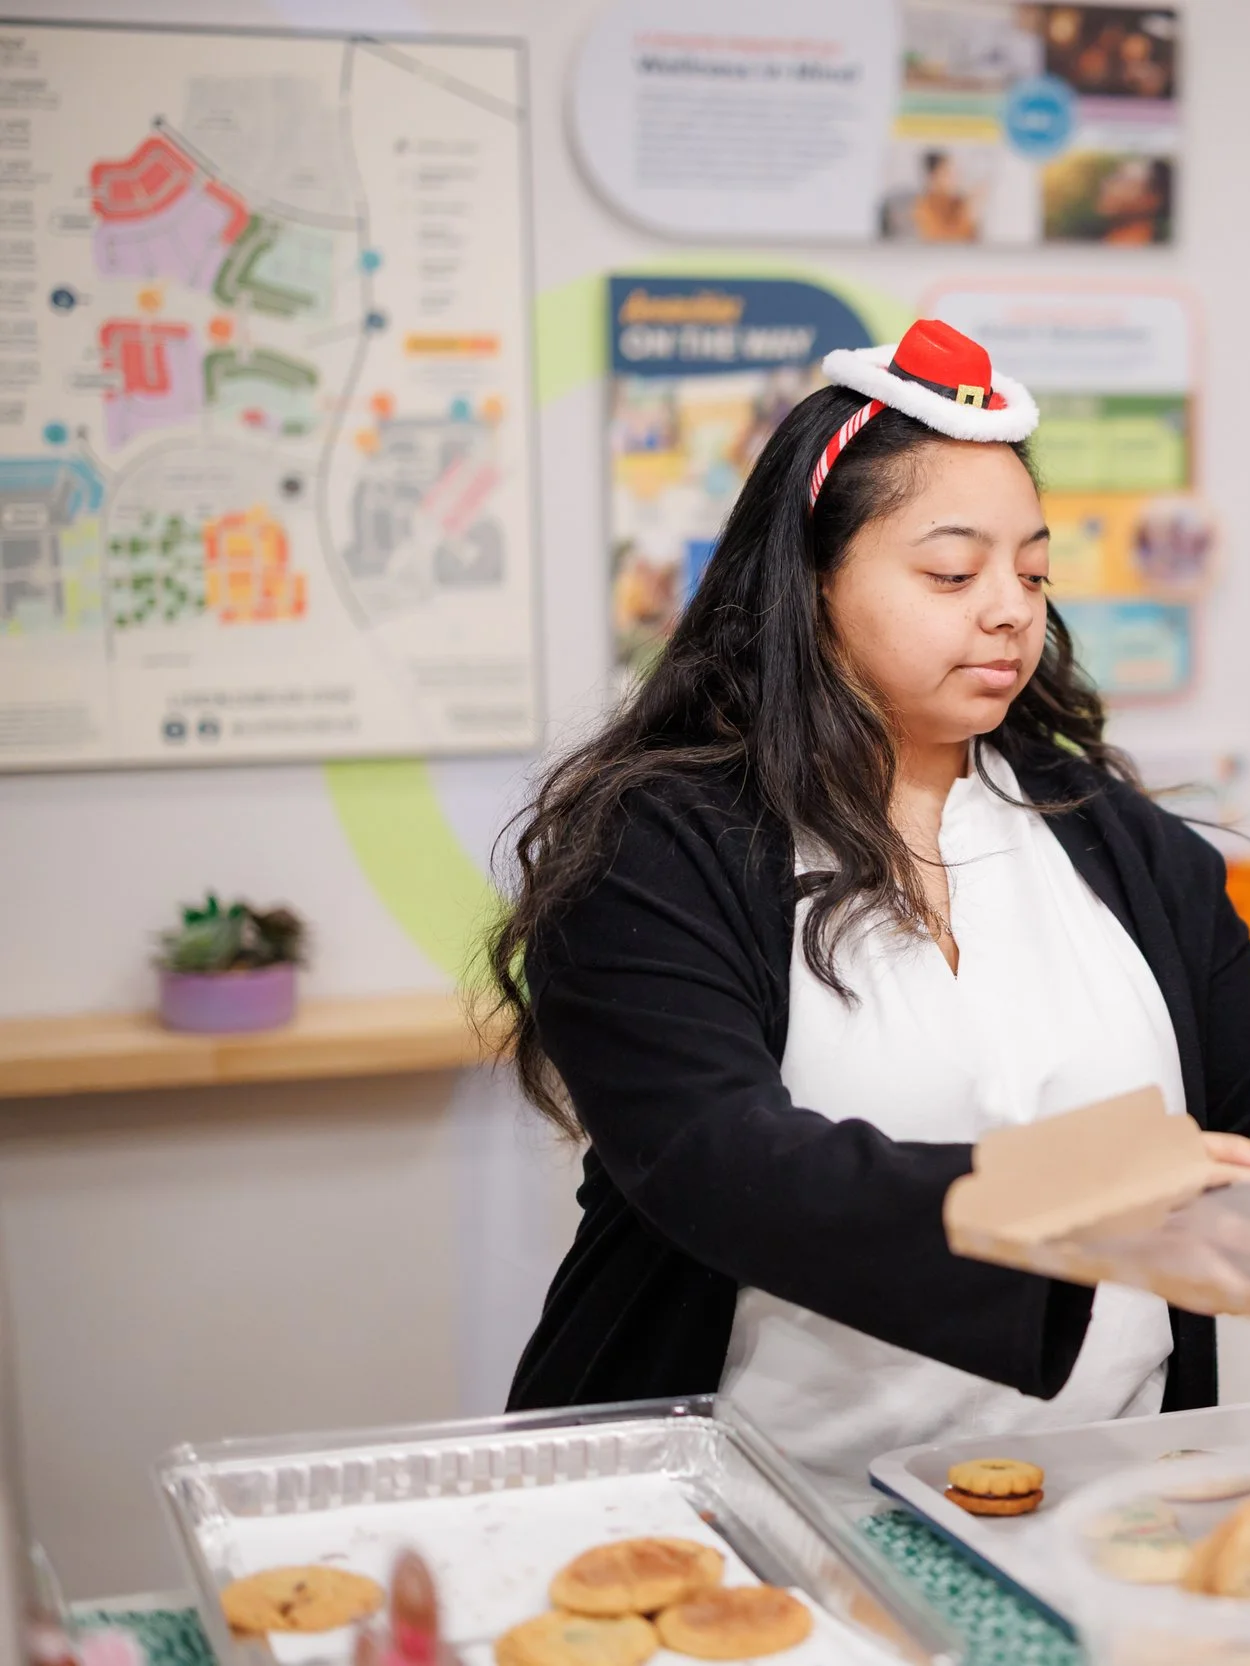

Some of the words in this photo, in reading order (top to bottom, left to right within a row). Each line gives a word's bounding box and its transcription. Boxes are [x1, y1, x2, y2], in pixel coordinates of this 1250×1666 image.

[621, 326, 674, 360] ON
[679, 326, 735, 361] THE
[742, 327, 814, 360] WAY
